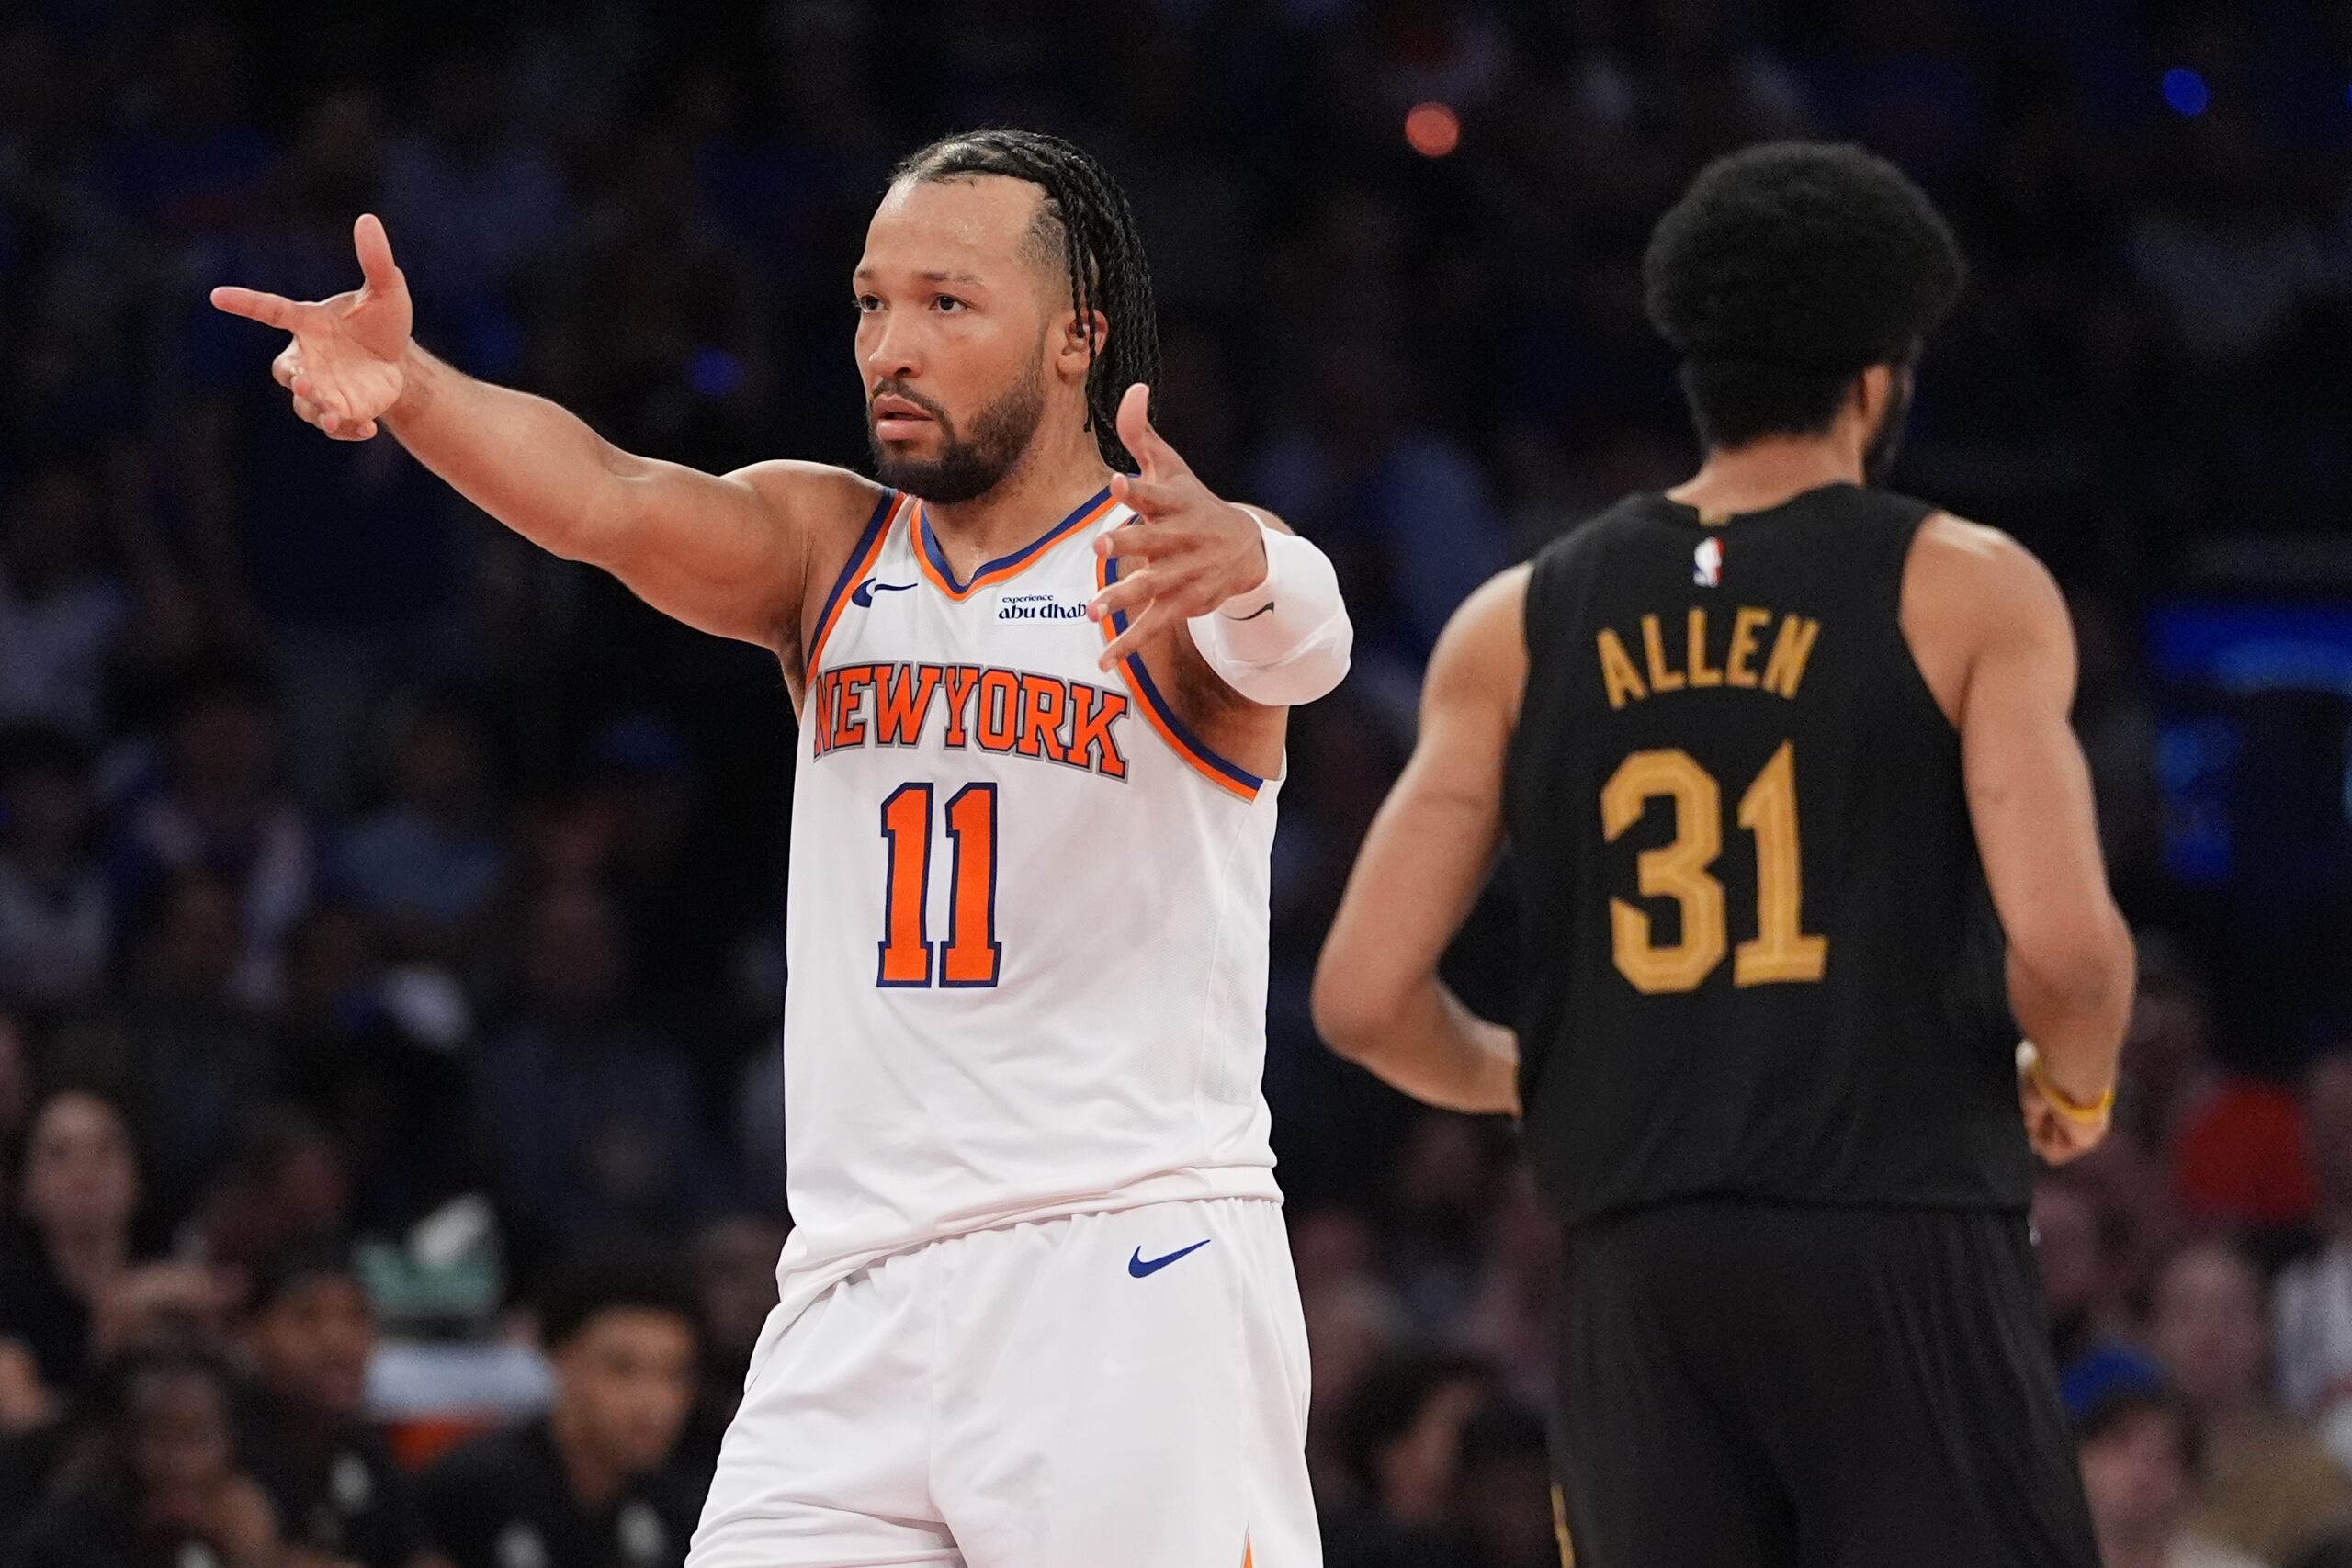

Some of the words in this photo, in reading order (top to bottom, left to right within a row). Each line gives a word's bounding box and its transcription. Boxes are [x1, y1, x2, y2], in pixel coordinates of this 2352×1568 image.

[998, 605, 1035, 619] abu
[1040, 602, 1089, 619] dhab
[1002, 594, 1054, 604] experience
[1596, 606, 1821, 710] ALLEN
[814, 661, 943, 761] NEW
[943, 663, 1132, 783] YORK
[877, 782, 1001, 987] 11
[1600, 739, 1829, 995] 31
